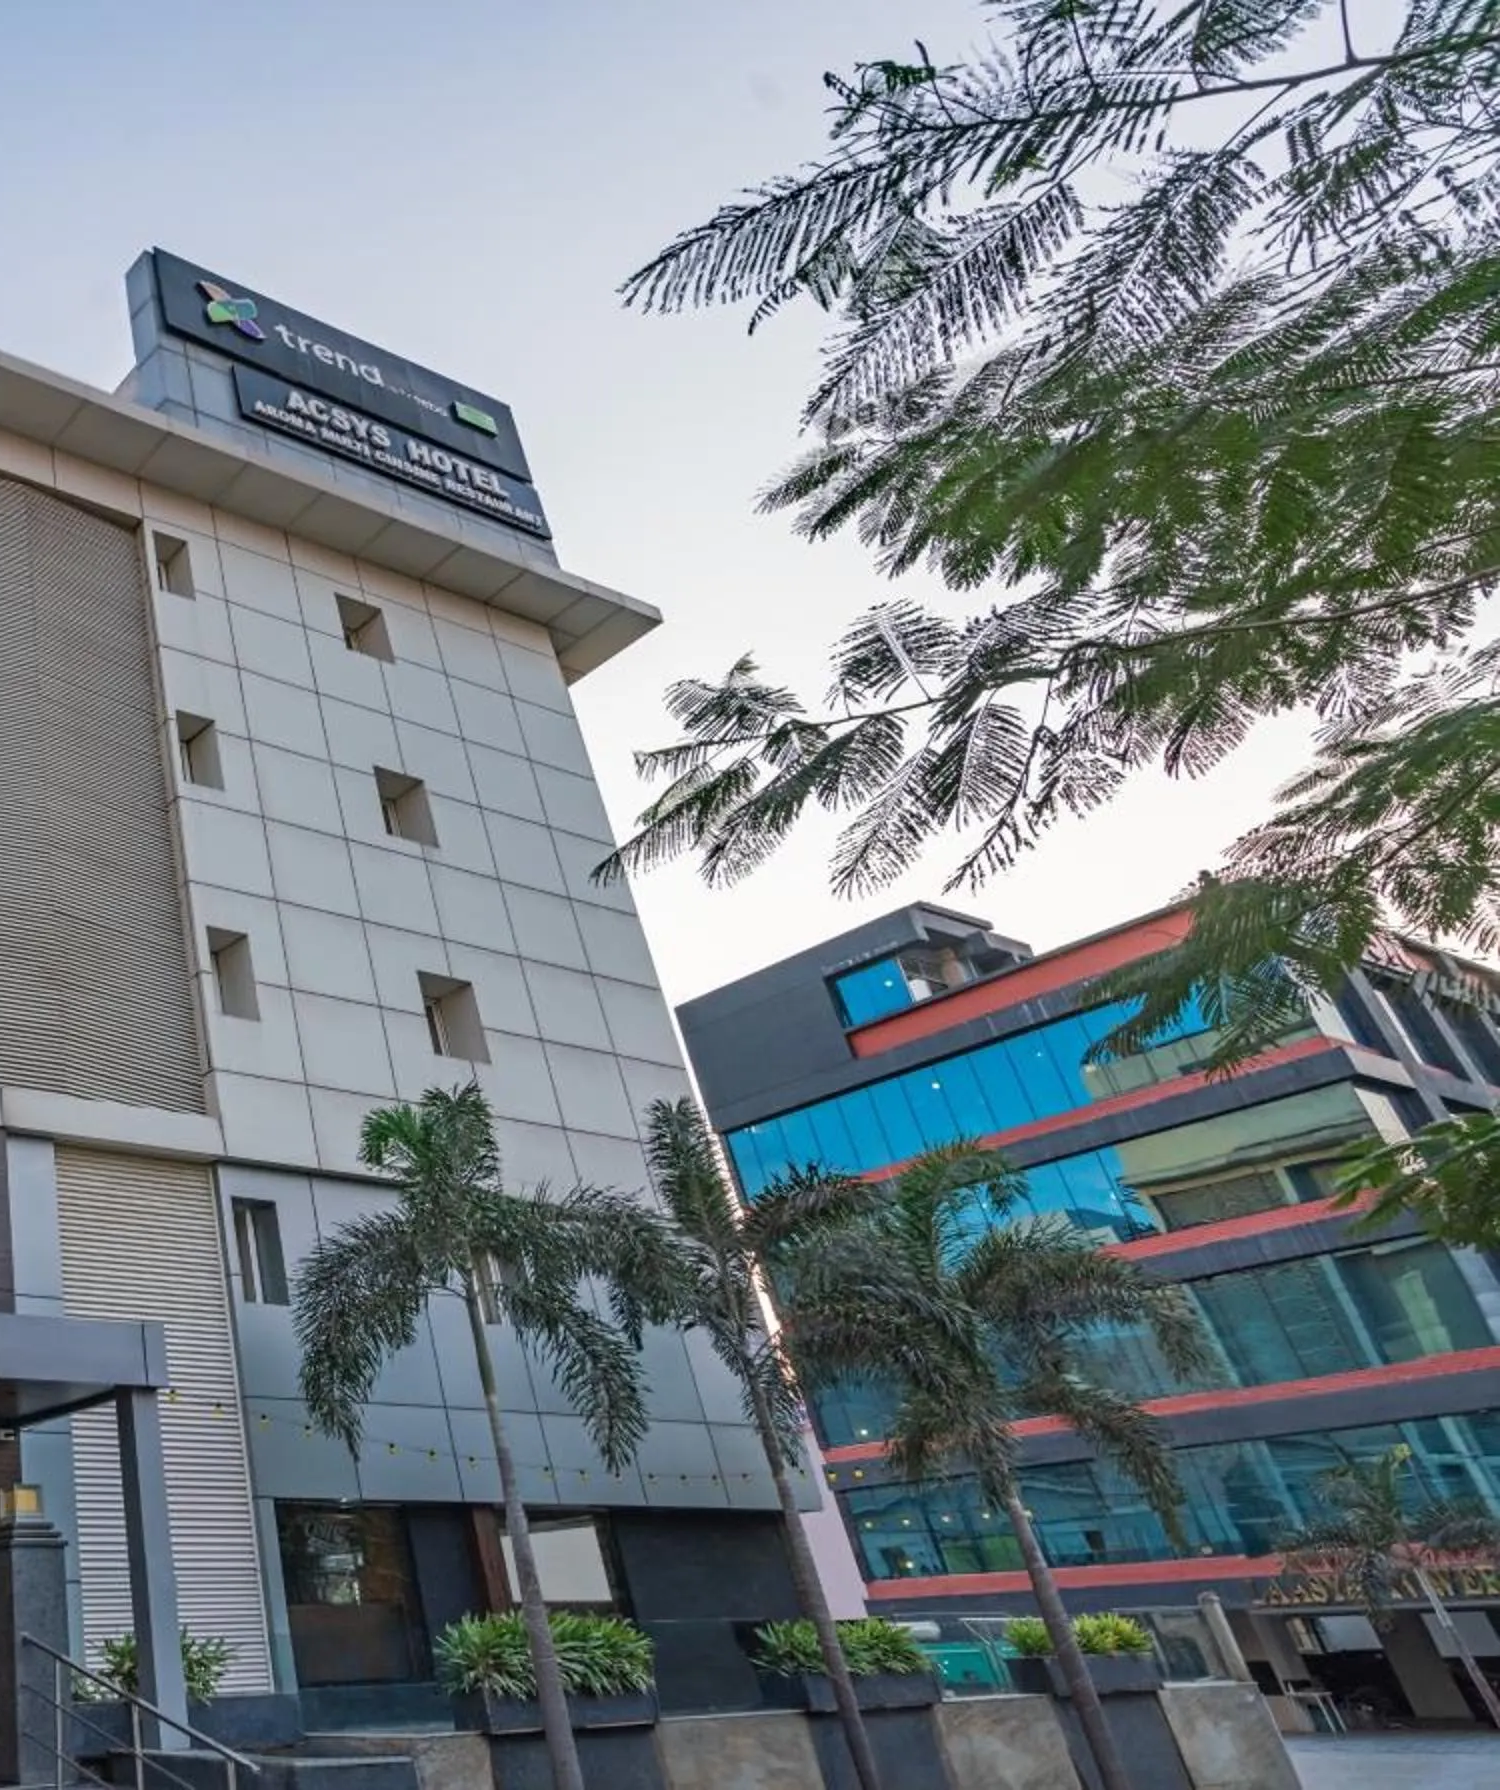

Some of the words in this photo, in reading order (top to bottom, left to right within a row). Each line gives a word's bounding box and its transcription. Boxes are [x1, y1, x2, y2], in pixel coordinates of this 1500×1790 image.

[274, 324, 384, 387] trend
[254, 400, 317, 435] AROMA
[321, 427, 371, 458] MULTI
[286, 391, 392, 448] ACSYS
[408, 440, 510, 498] HOTEL
